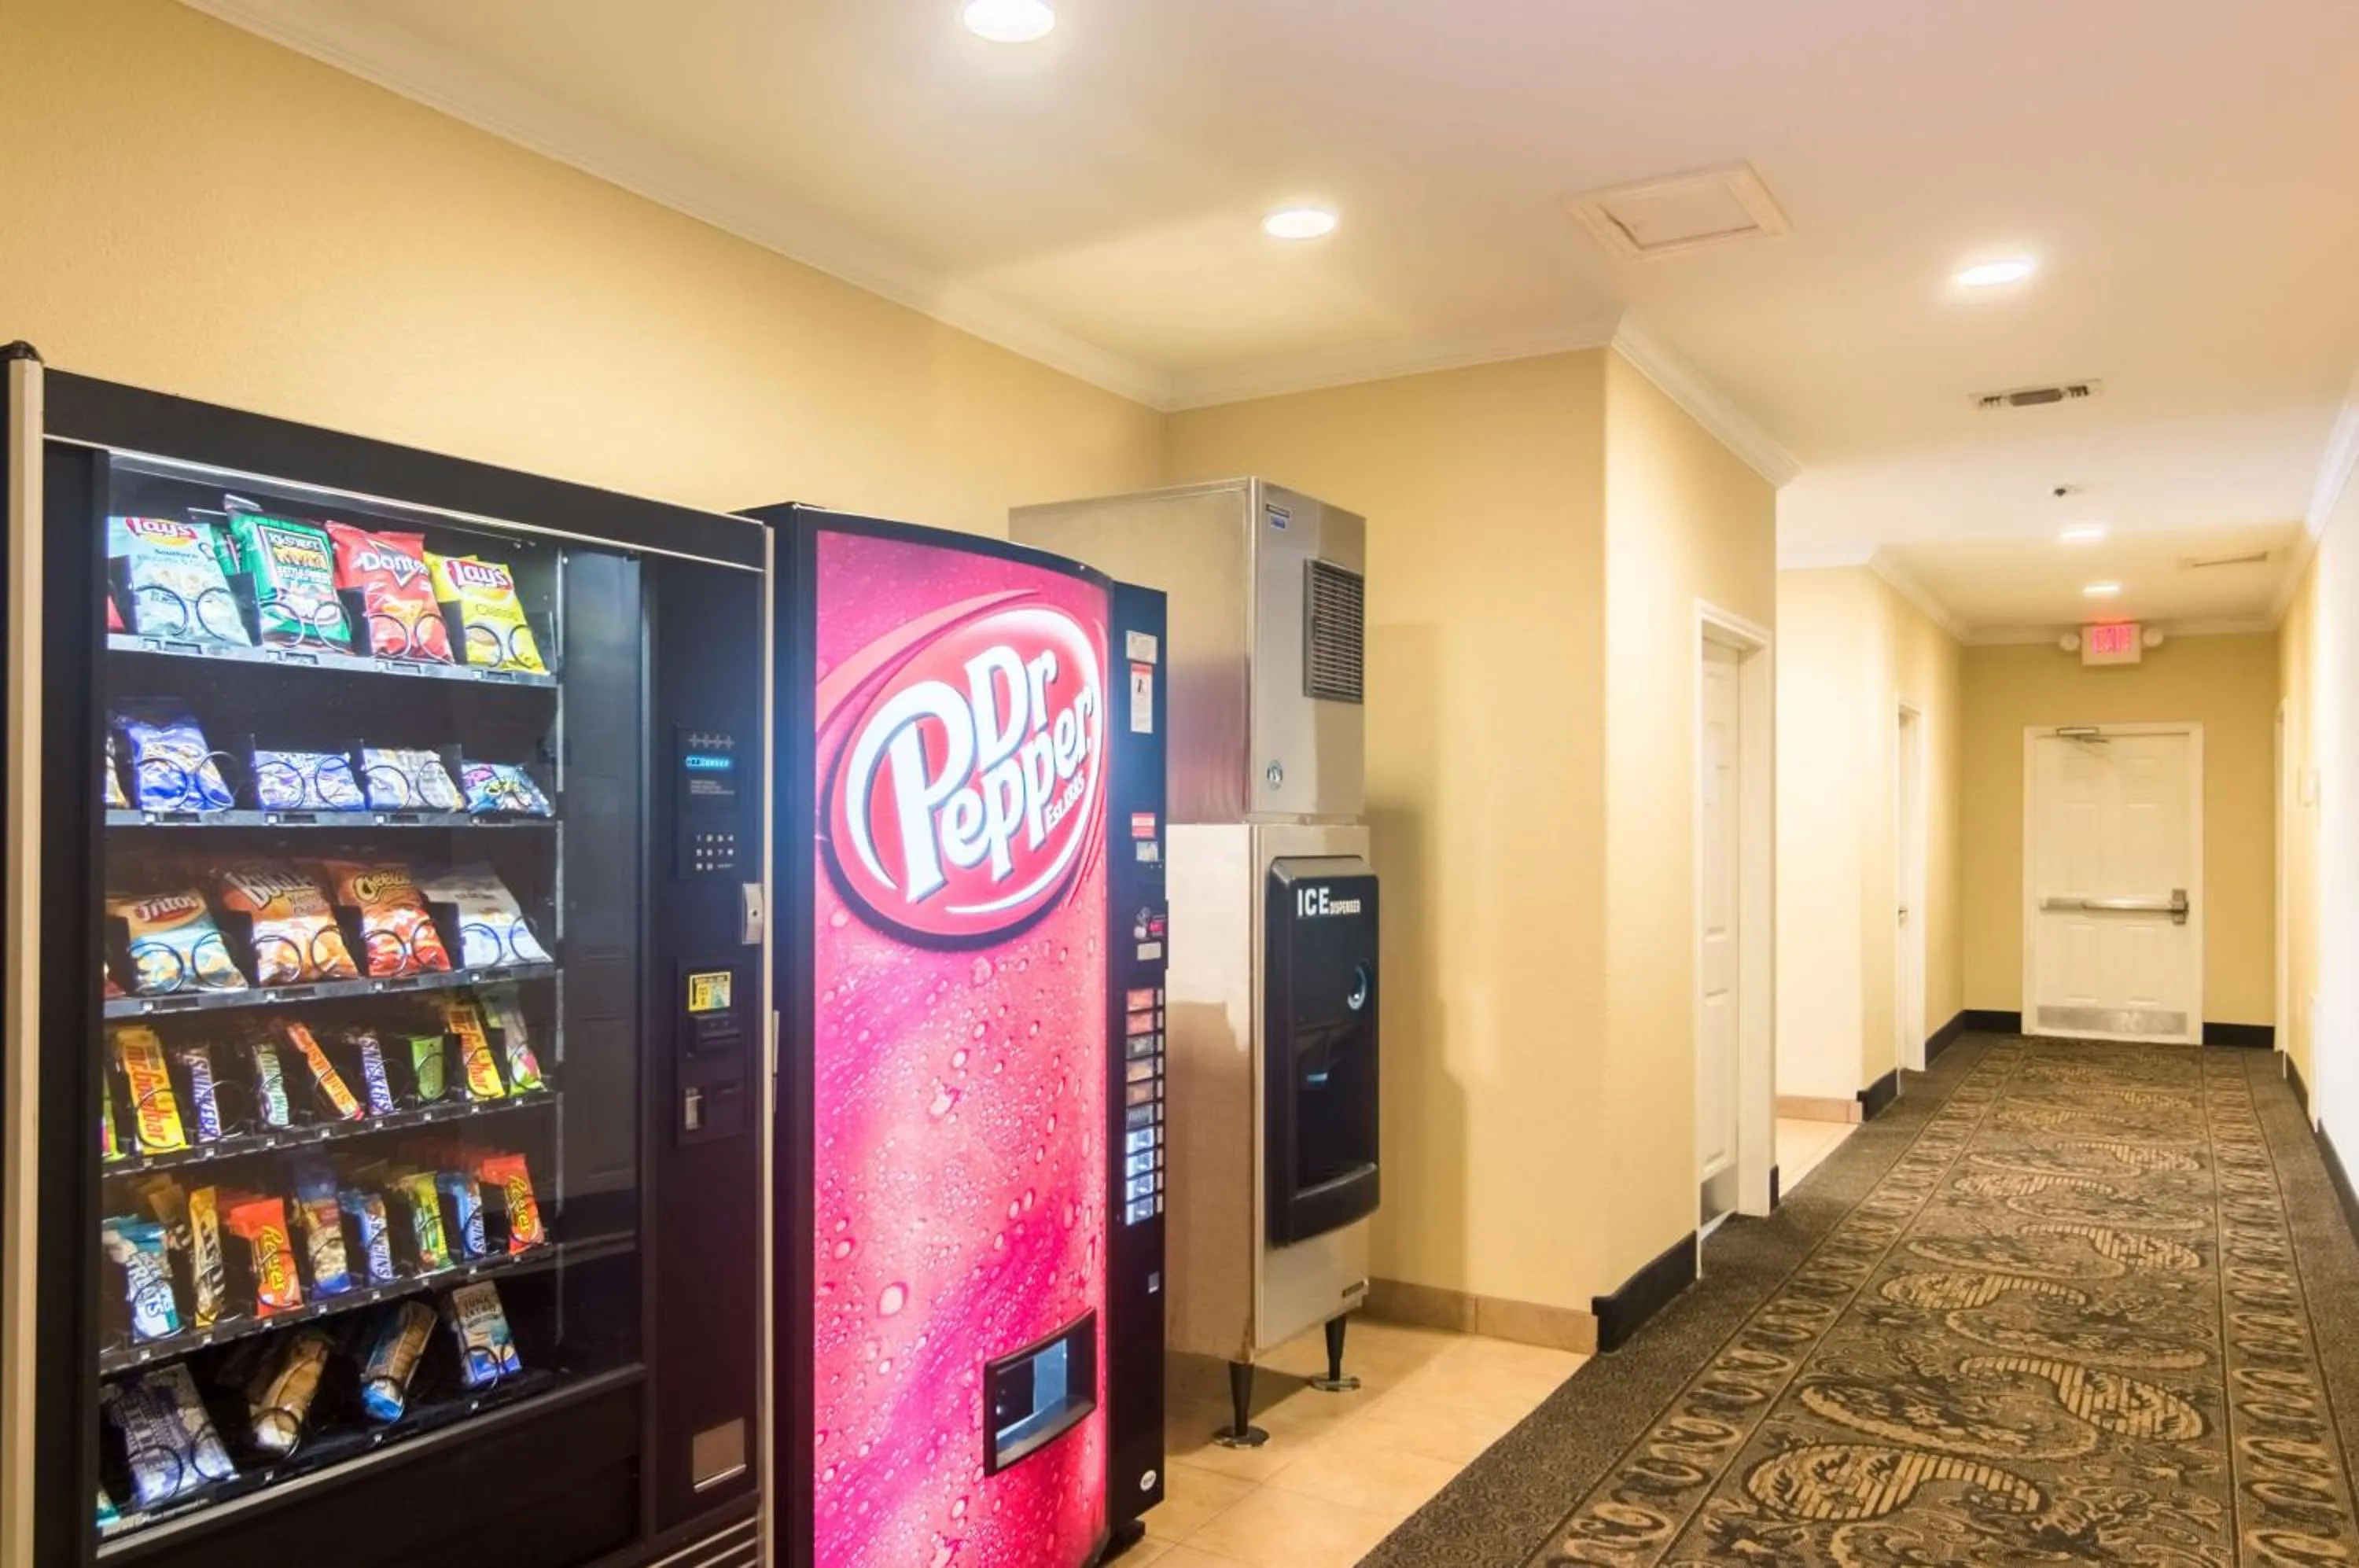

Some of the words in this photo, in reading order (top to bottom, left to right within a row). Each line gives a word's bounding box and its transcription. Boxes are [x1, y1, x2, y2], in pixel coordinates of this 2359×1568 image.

[964, 645, 1058, 771] Dr
[845, 679, 1095, 904] Pepper
[1297, 886, 1330, 917] ICE
